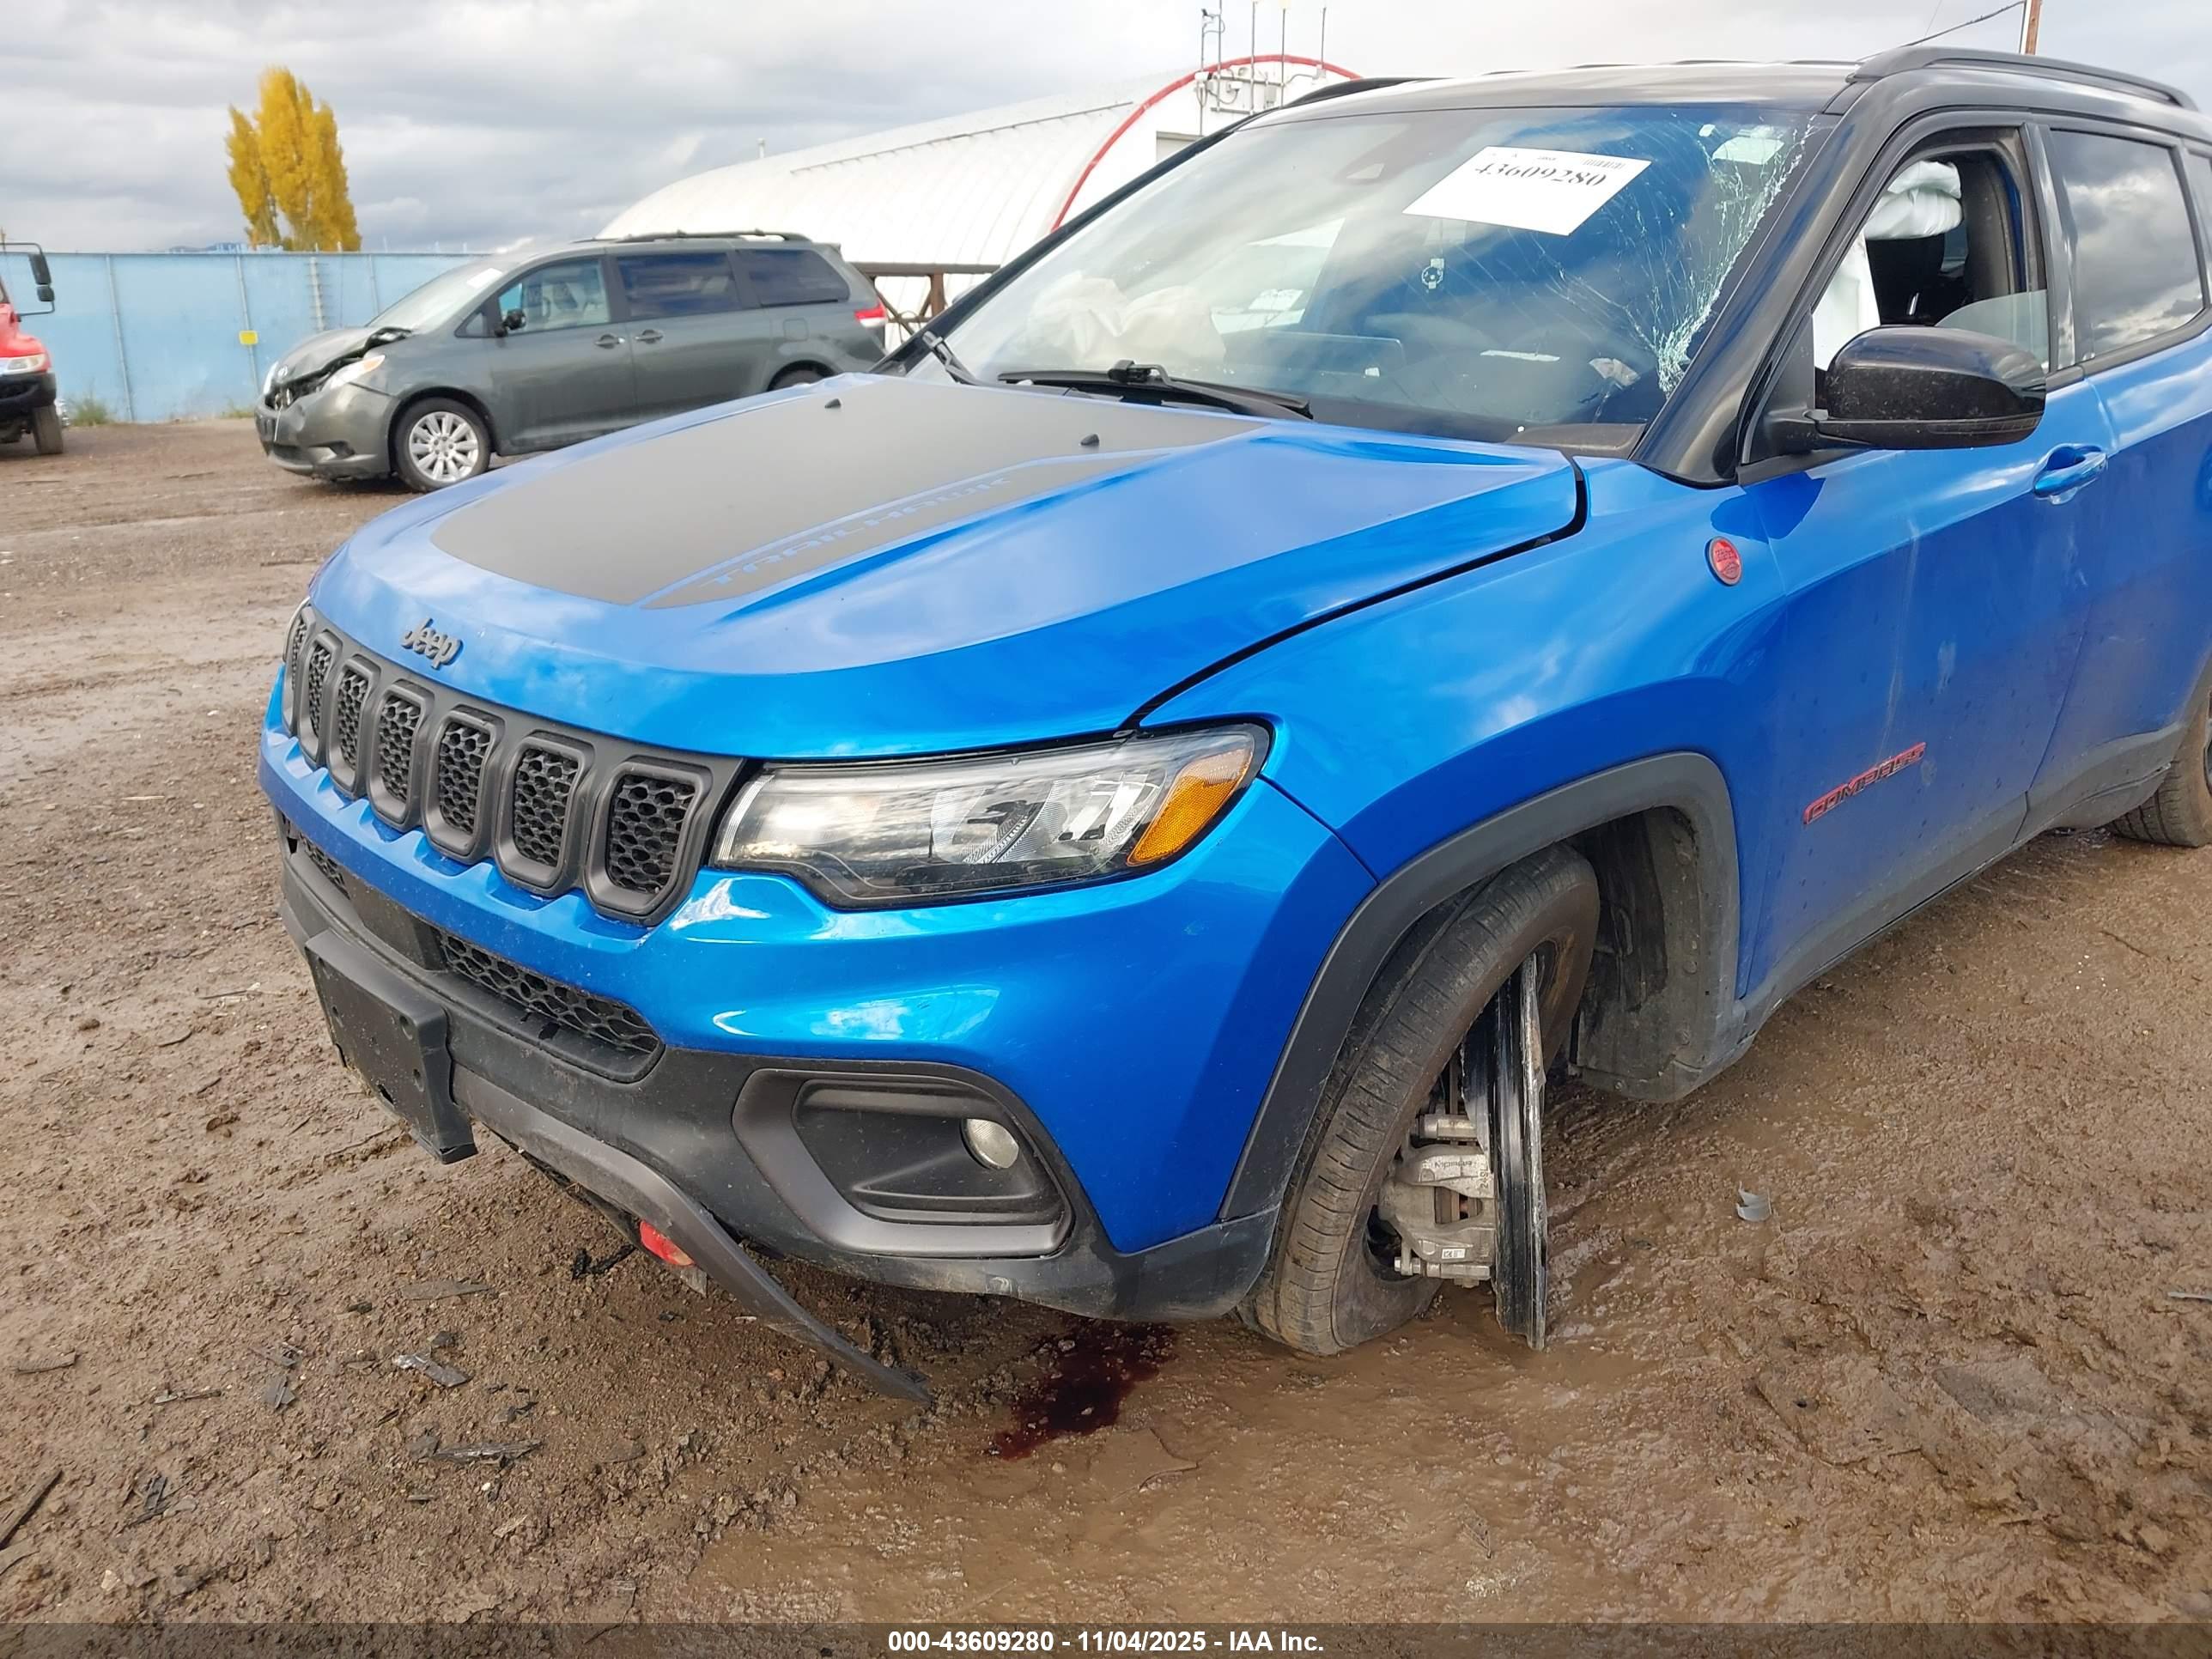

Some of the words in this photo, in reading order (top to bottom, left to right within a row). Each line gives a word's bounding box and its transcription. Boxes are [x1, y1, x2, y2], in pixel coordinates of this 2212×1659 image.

[699, 477, 1012, 587] TRAILHAWK
[400, 617, 464, 671] Jeep
[1802, 741, 1927, 825] COMPASS
